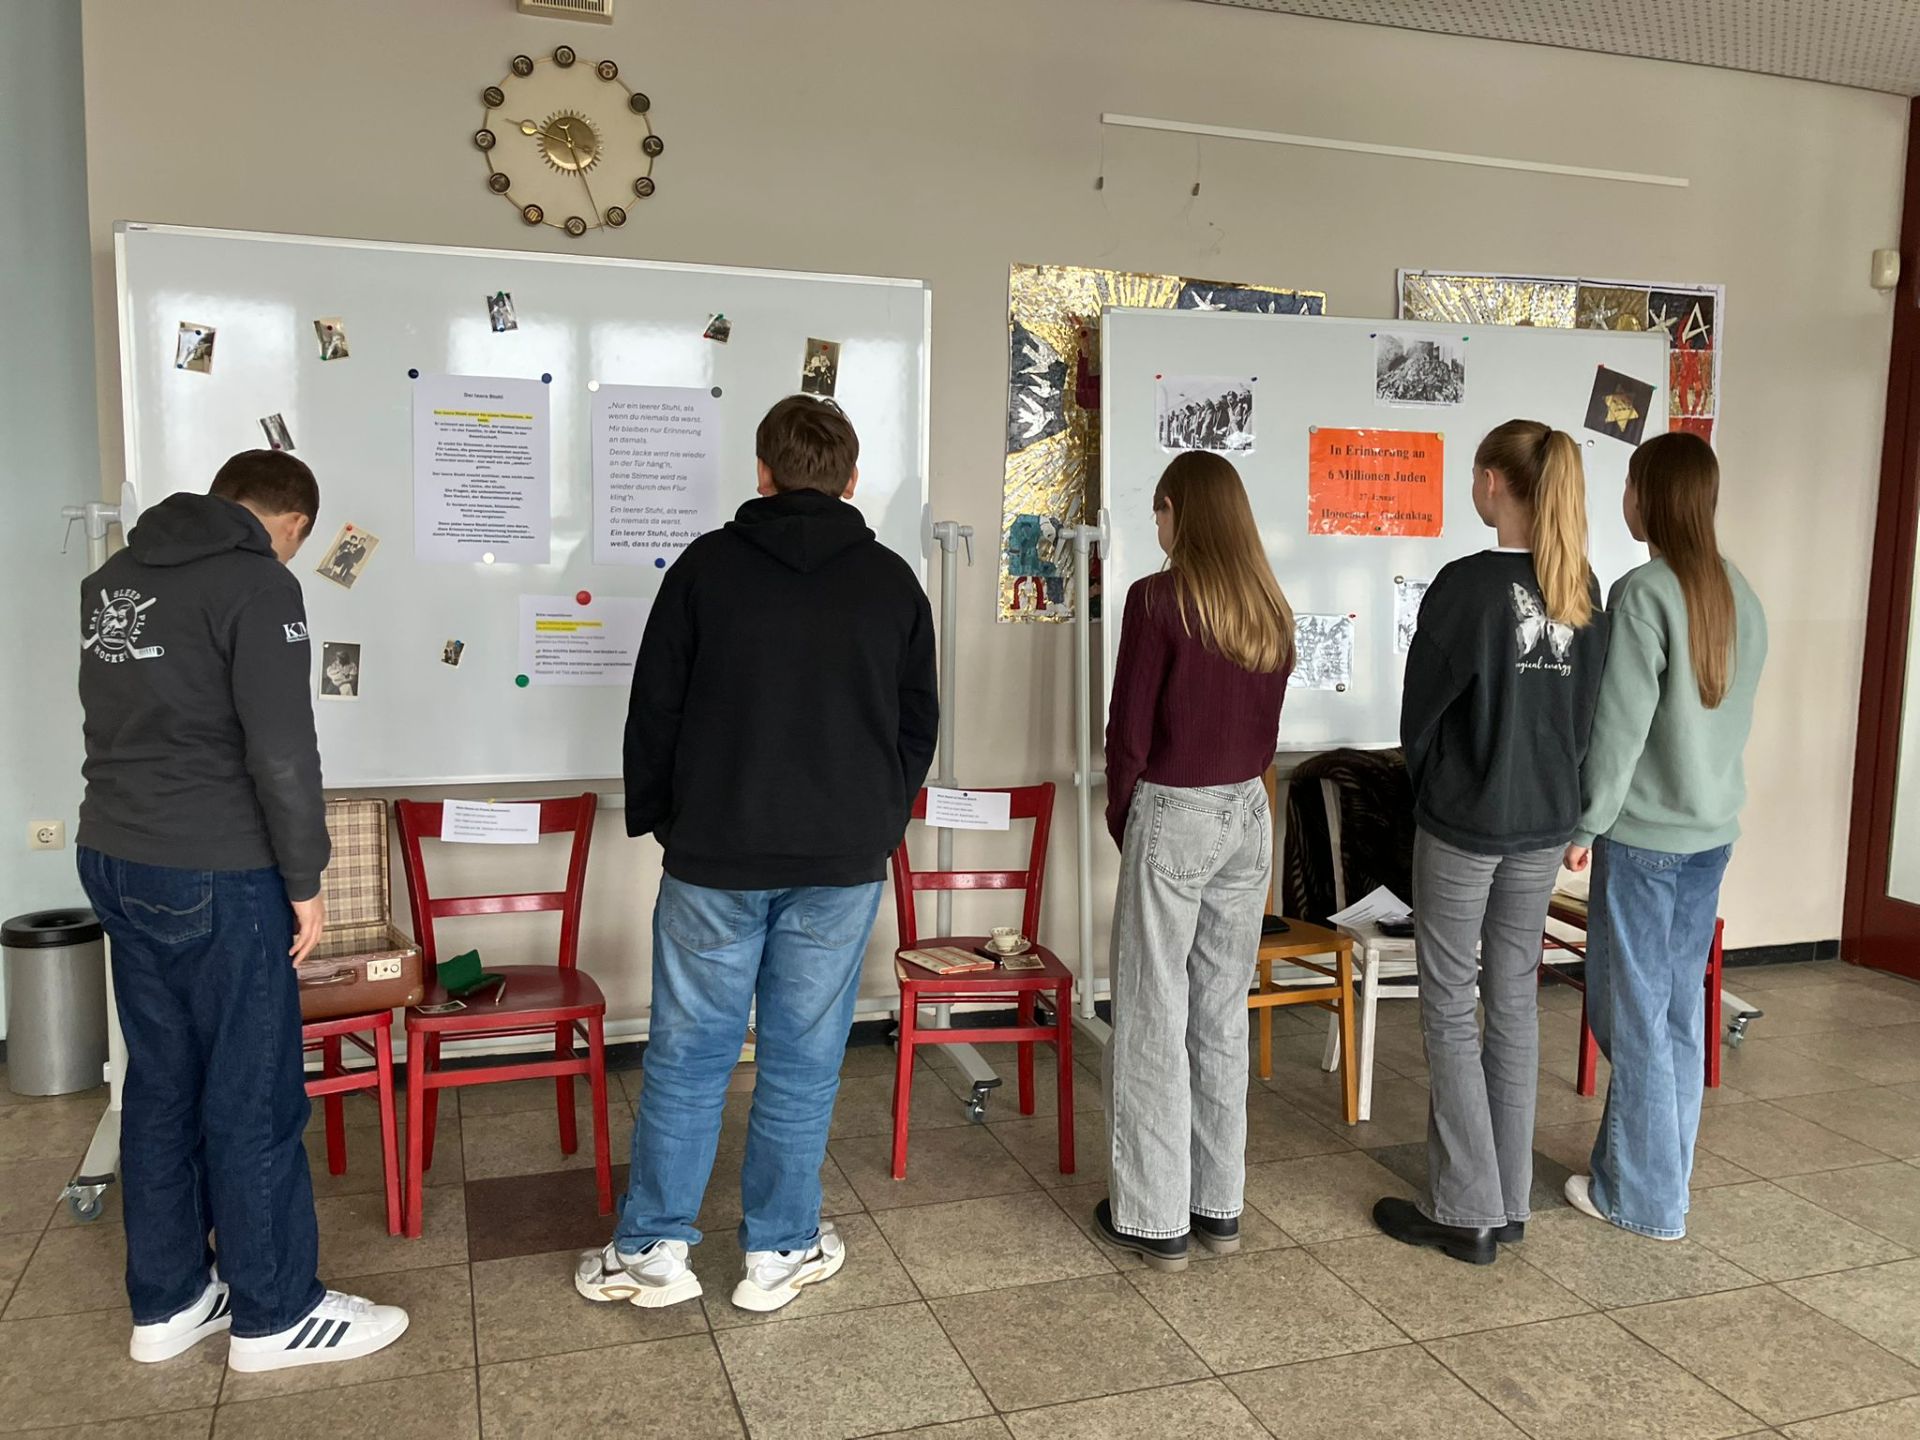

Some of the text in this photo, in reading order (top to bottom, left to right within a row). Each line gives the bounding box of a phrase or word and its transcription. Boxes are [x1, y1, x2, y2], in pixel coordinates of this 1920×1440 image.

[663, 427, 701, 436] Erinnerung
[1330, 444, 1341, 456] In
[1412, 450, 1425, 458] an
[1328, 469, 1427, 483] 6 Millionen Juden
[113, 589, 141, 600] SLEEP
[89, 608, 100, 630] EAT
[130, 614, 146, 643] PLAY
